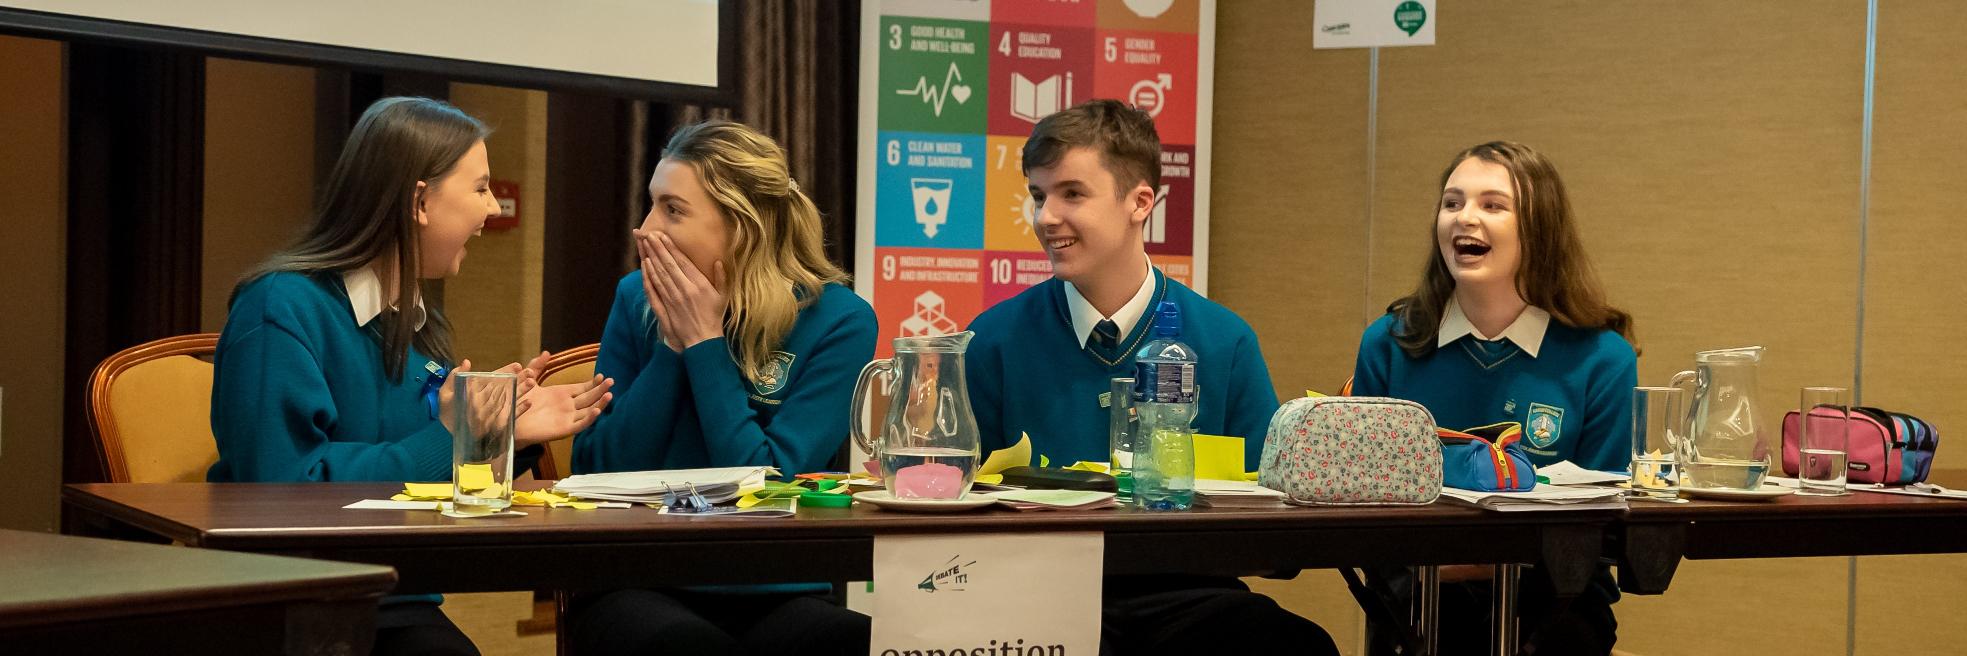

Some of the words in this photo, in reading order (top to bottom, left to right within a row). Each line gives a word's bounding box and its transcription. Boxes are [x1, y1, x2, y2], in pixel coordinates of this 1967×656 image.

[889, 24, 902, 51] 3
[910, 25, 934, 38] GOOD
[935, 26, 965, 40] HEALTH
[1018, 31, 1051, 45] QUALITY
[910, 39, 928, 52] AND
[998, 31, 1011, 57] 4
[1104, 37, 1117, 63] 5
[1124, 38, 1155, 51] GENDER
[1018, 45, 1062, 59] EDUCATION
[1124, 51, 1162, 65] EQUALITY
[887, 140, 900, 166] 6
[908, 140, 935, 153] CLEAN
[936, 142, 962, 155] WATER
[908, 154, 926, 167] AND
[927, 155, 973, 169] SANITATION
[997, 144, 1007, 170] 7
[1173, 152, 1189, 165] AND
[882, 255, 896, 281] 9
[937, 257, 979, 270] INNOVATION
[990, 258, 1012, 284] 10
[900, 270, 915, 281] AND
[915, 270, 978, 284] INFRASTRUCTURE
[954, 573, 968, 584] IT!
